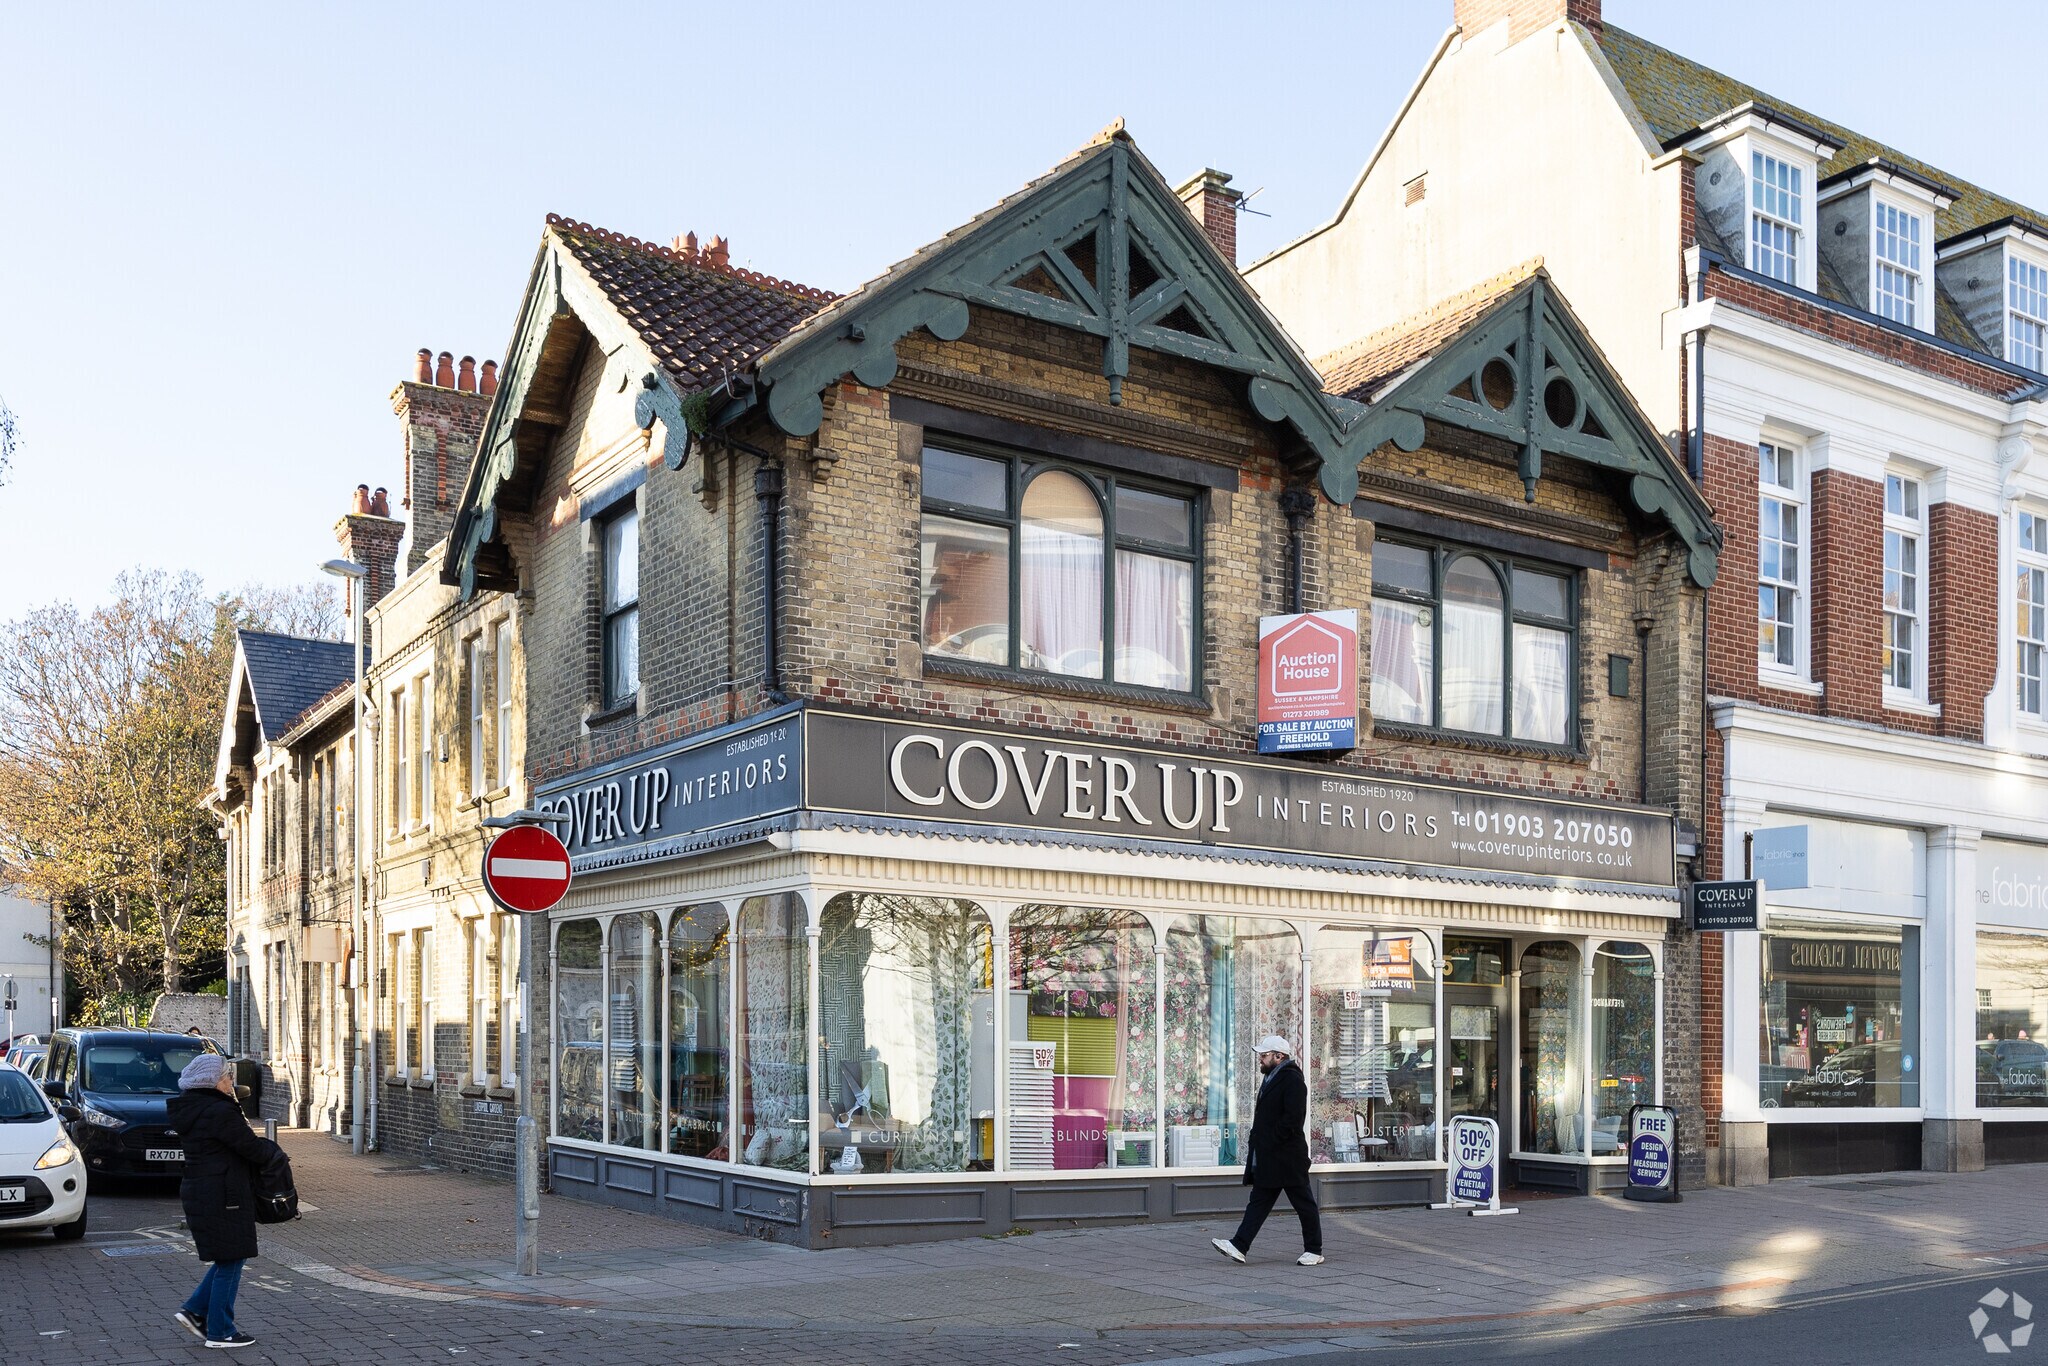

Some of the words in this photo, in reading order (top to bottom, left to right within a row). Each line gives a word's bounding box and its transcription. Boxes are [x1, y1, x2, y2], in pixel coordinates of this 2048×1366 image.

[1278, 652, 1336, 667] Auction
[1283, 667, 1330, 680] House
[1304, 694, 1339, 702] HAMPSHIRE
[1304, 709, 1329, 717] 201989
[1258, 723, 1275, 733] FOR
[1276, 722, 1298, 732] SALE
[1300, 721, 1313, 731] BY
[1314, 718, 1353, 730] AUCTION
[1279, 732, 1330, 743] FREEHOLD
[726, 733, 769, 757] ESTABLISHED
[674, 754, 788, 807] INTERIORS
[890, 734, 1152, 826] COVER
[1157, 762, 1244, 833] UP
[1321, 780, 1387, 799] ESTABLISHED
[1389, 788, 1414, 802] 1920
[629, 766, 669, 834] UP
[1257, 795, 1439, 838] INTERIORS
[1451, 810, 1471, 828] Tel
[1474, 809, 1544, 839] 01903
[1553, 818, 1633, 849] 207050
[1763, 848, 1792, 860] fabric
[1698, 889, 1737, 902] COVER
[1738, 888, 1754, 900] UP
[1976, 890, 1990, 904] he
[1035, 1048, 1054, 1060] 50%
[1815, 1065, 1849, 1084] fabric
[2008, 1067, 2037, 1085] fabric
[1640, 1117, 1666, 1132] FREE
[868, 1130, 948, 1143] CURTAINS
[1057, 1129, 1108, 1142] BLINDS
[1459, 1128, 1491, 1149] 50%
[1641, 1142, 1664, 1152] DESIGN
[150, 1150, 176, 1160] RX70
[1462, 1147, 1485, 1162] OFF
[1645, 1151, 1658, 1160] AND
[1633, 1159, 1668, 1170] MEASURING
[1462, 1169, 1482, 1180] WOOD
[1636, 1168, 1663, 1178] SERVICE
[1456, 1178, 1486, 1190] VENETIAN
[0, 1189, 17, 1201] LX
[1458, 1187, 1481, 1198] BLINDS
